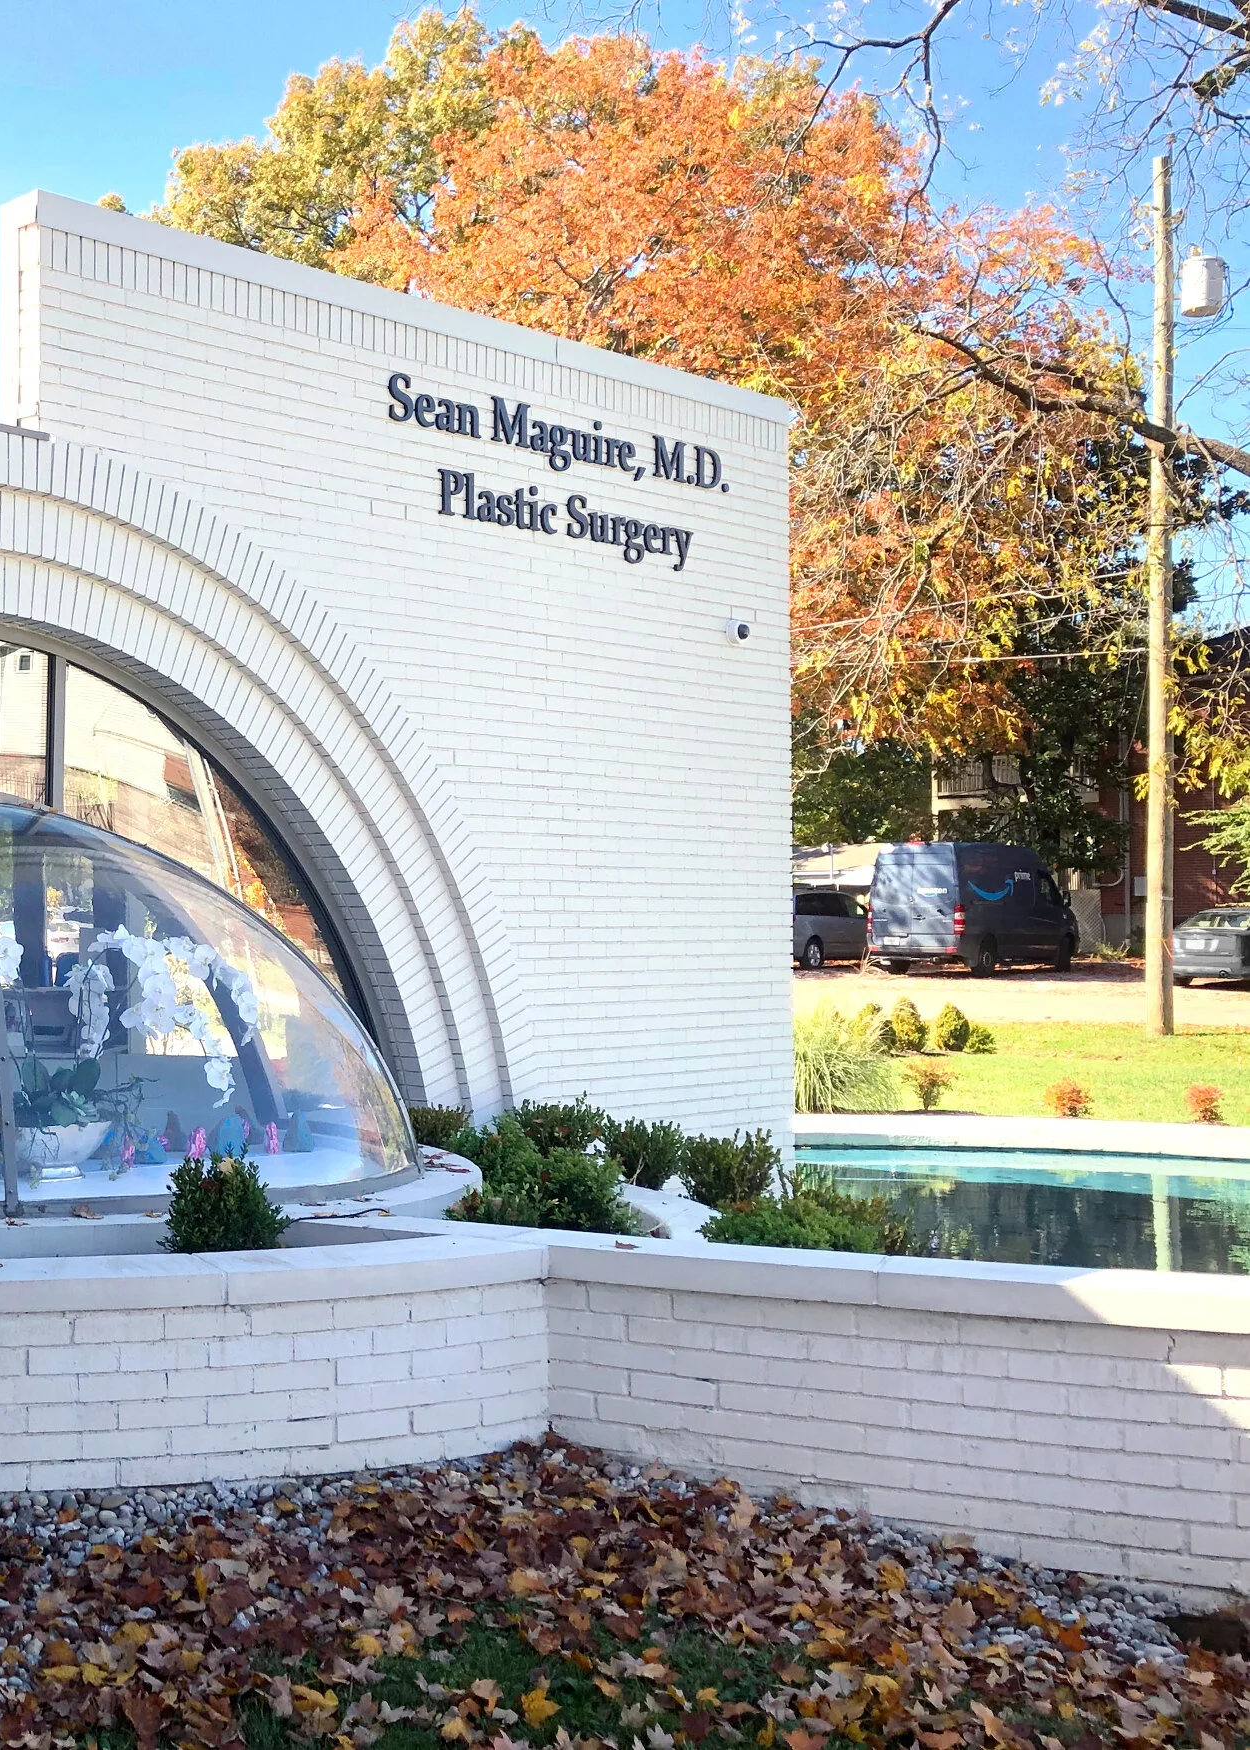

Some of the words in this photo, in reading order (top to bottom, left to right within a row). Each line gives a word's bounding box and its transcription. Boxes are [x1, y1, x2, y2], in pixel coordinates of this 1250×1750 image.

[388, 372, 482, 440] Sean
[491, 395, 646, 482] Maguire,
[652, 434, 730, 493] M.D.
[438, 468, 558, 535] Plastic
[567, 494, 694, 572] Surgery
